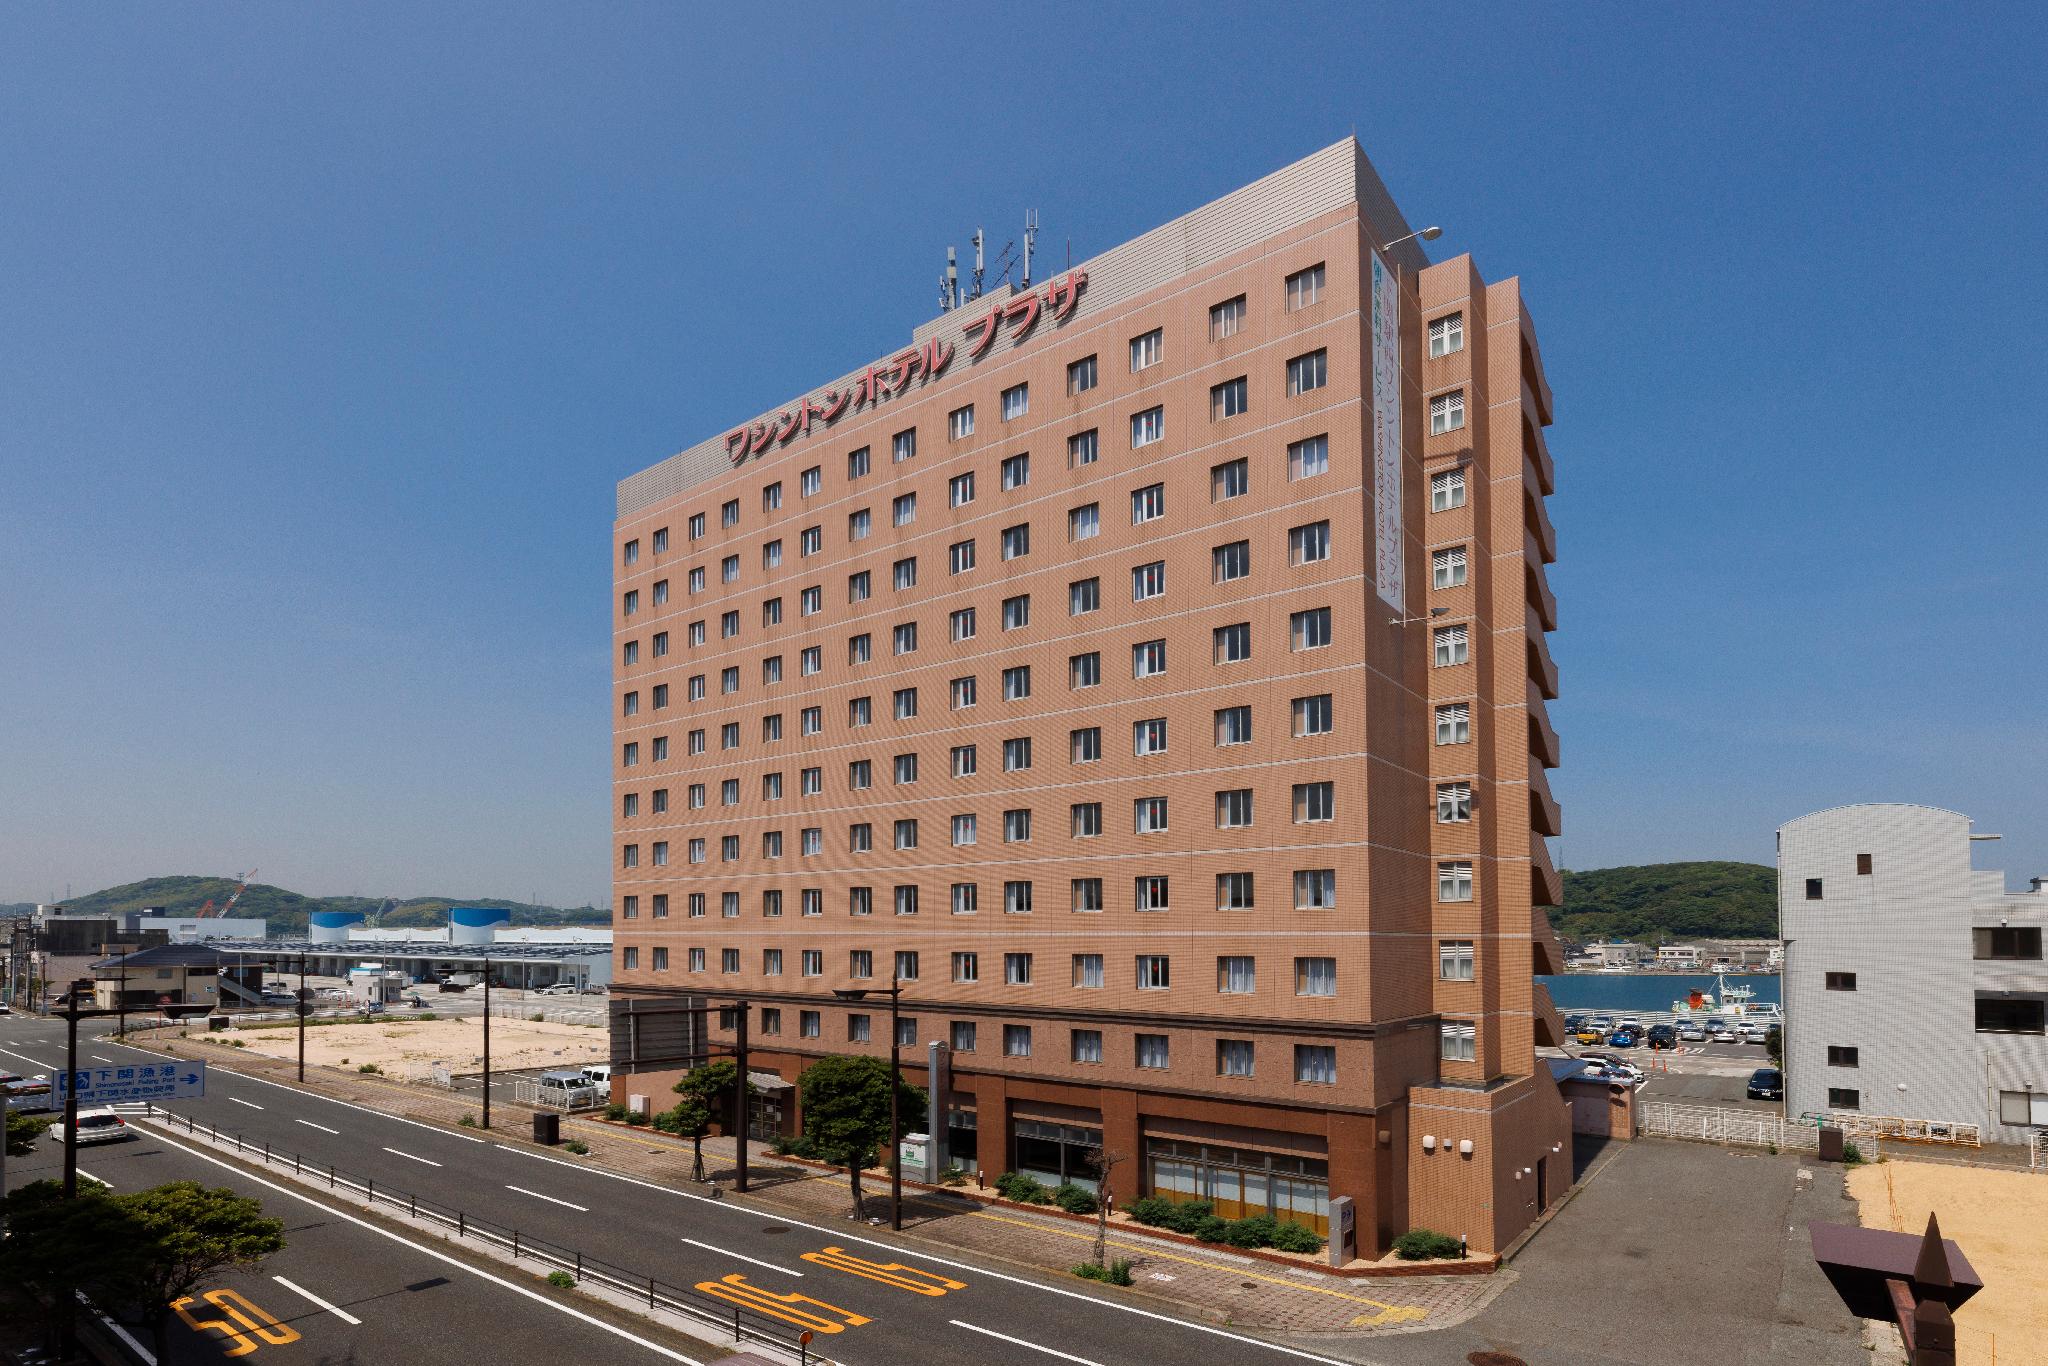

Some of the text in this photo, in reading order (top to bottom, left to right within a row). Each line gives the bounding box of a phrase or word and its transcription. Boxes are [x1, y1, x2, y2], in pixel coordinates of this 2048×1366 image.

[799, 1246, 969, 1297] 50
[169, 1288, 302, 1358] 50
[694, 1273, 874, 1334] 50
